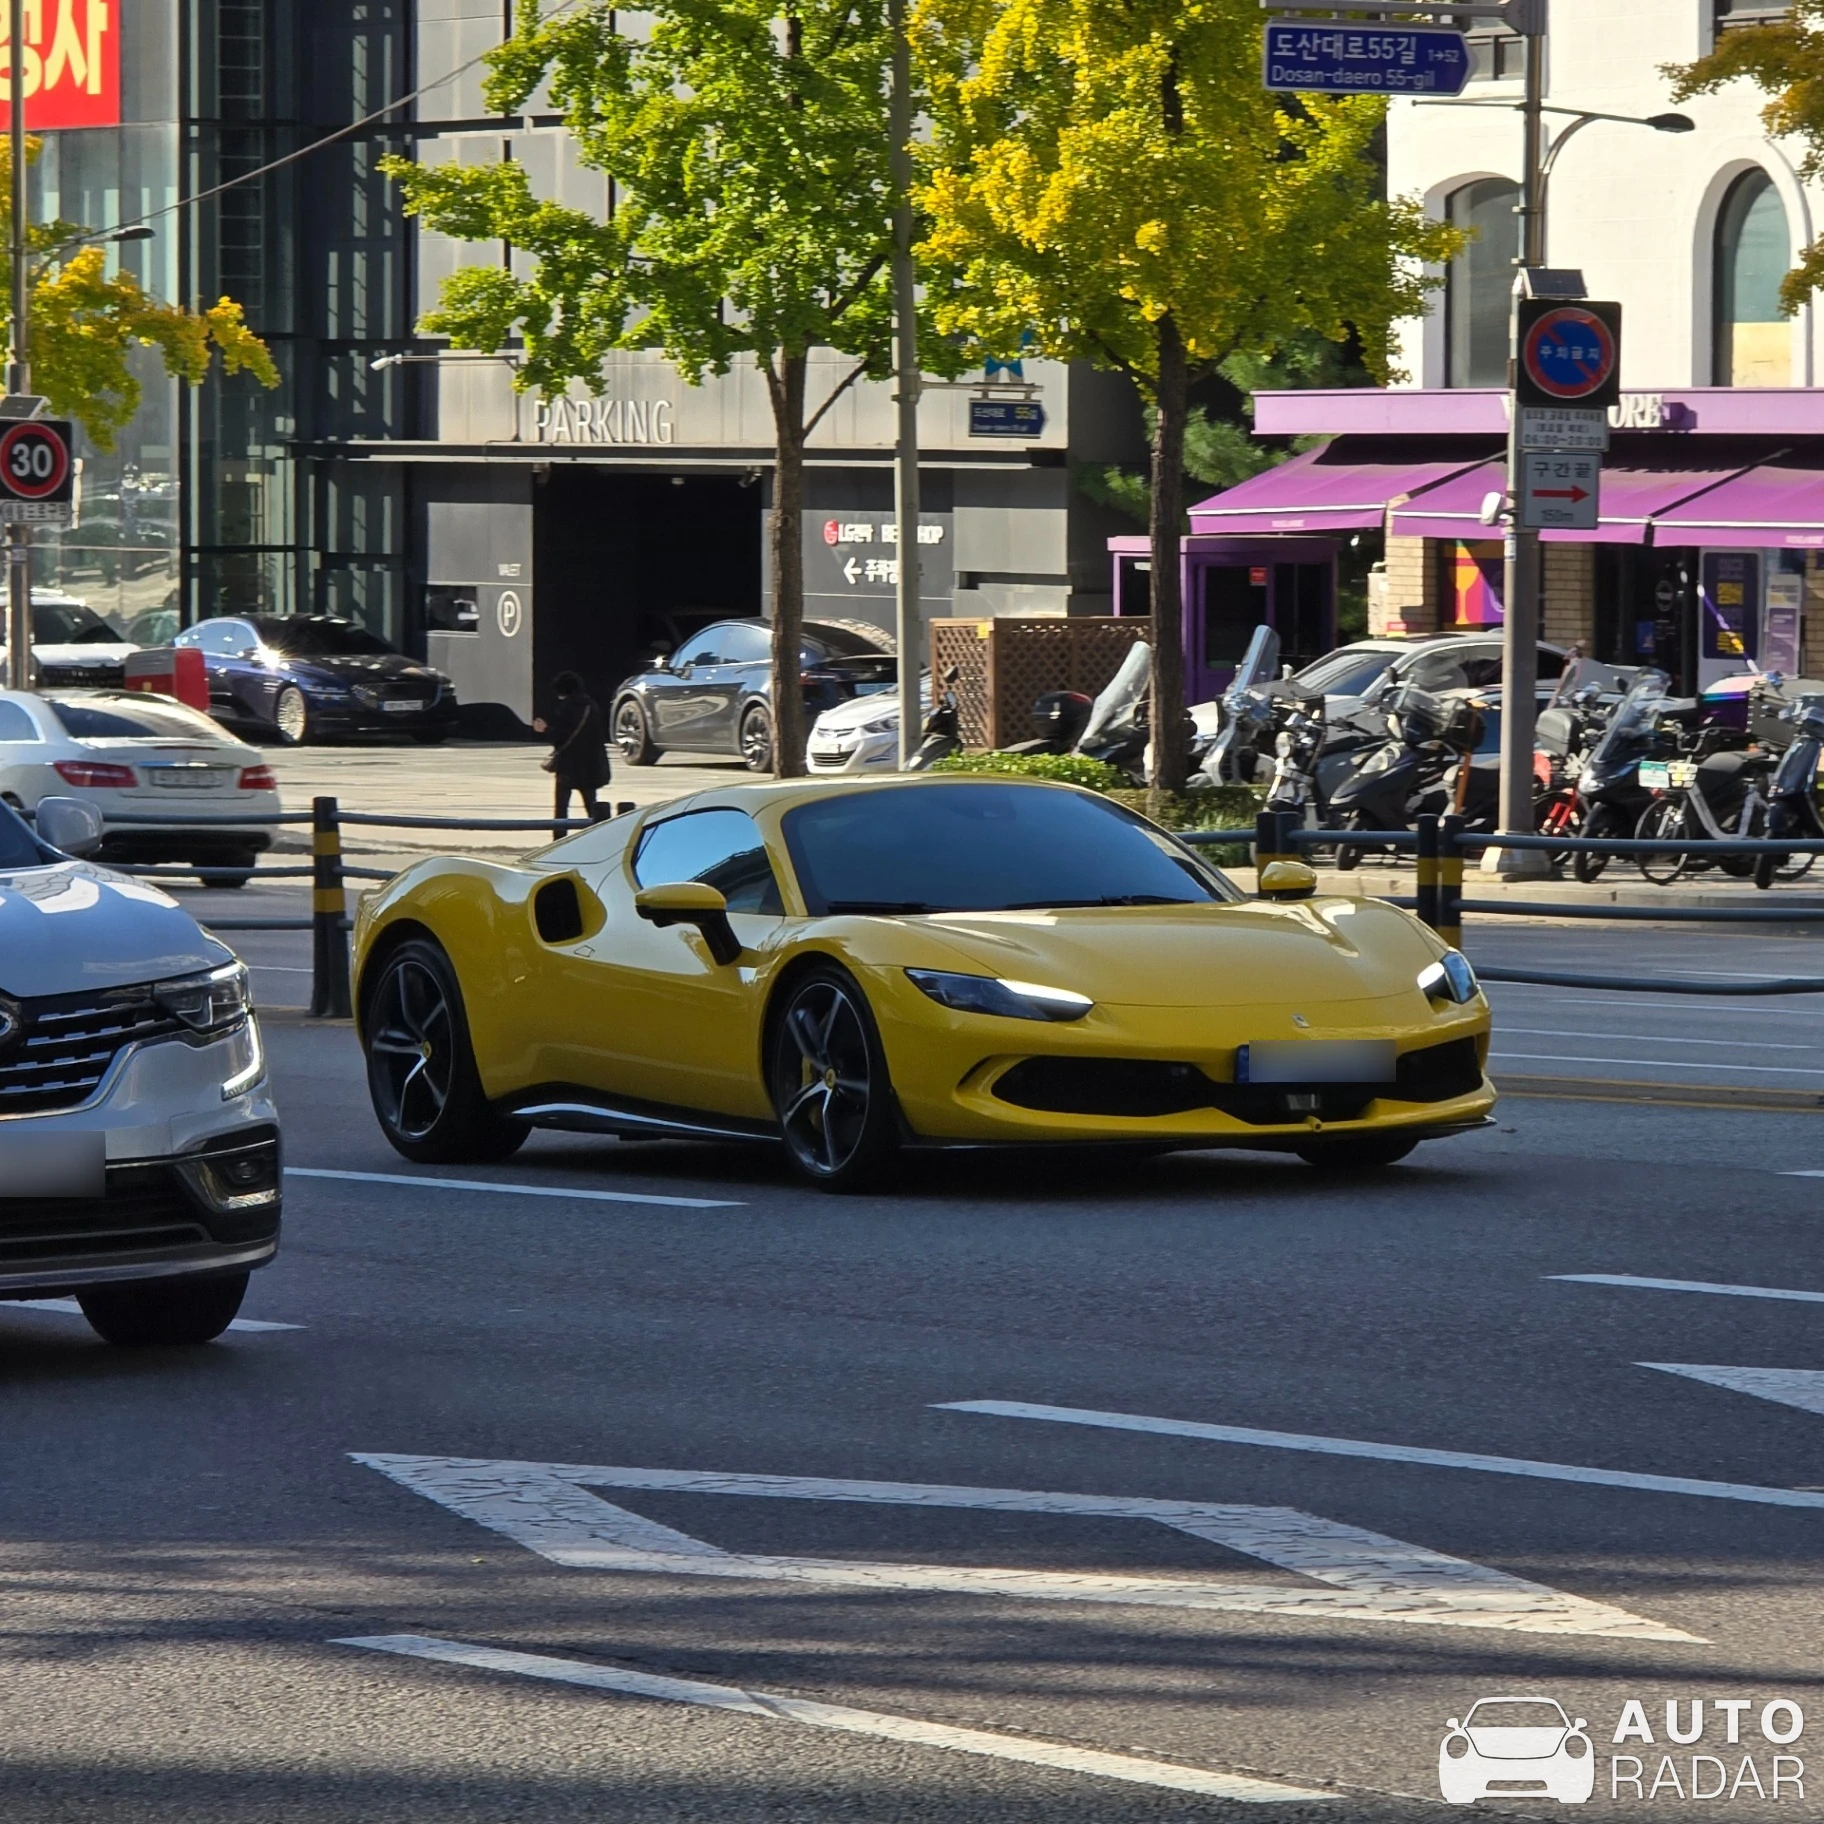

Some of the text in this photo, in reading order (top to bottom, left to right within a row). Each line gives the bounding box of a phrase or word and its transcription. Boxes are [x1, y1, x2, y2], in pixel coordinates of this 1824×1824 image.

[1272, 33, 1417, 65] 도산대로55길
[1271, 65, 1436, 90] Dosan-daero 55-gil
[1540, 345, 1600, 361] 주차금지
[533, 399, 672, 444] PARKING
[11, 443, 52, 478] 30
[1532, 462, 1592, 478] 구간끝
